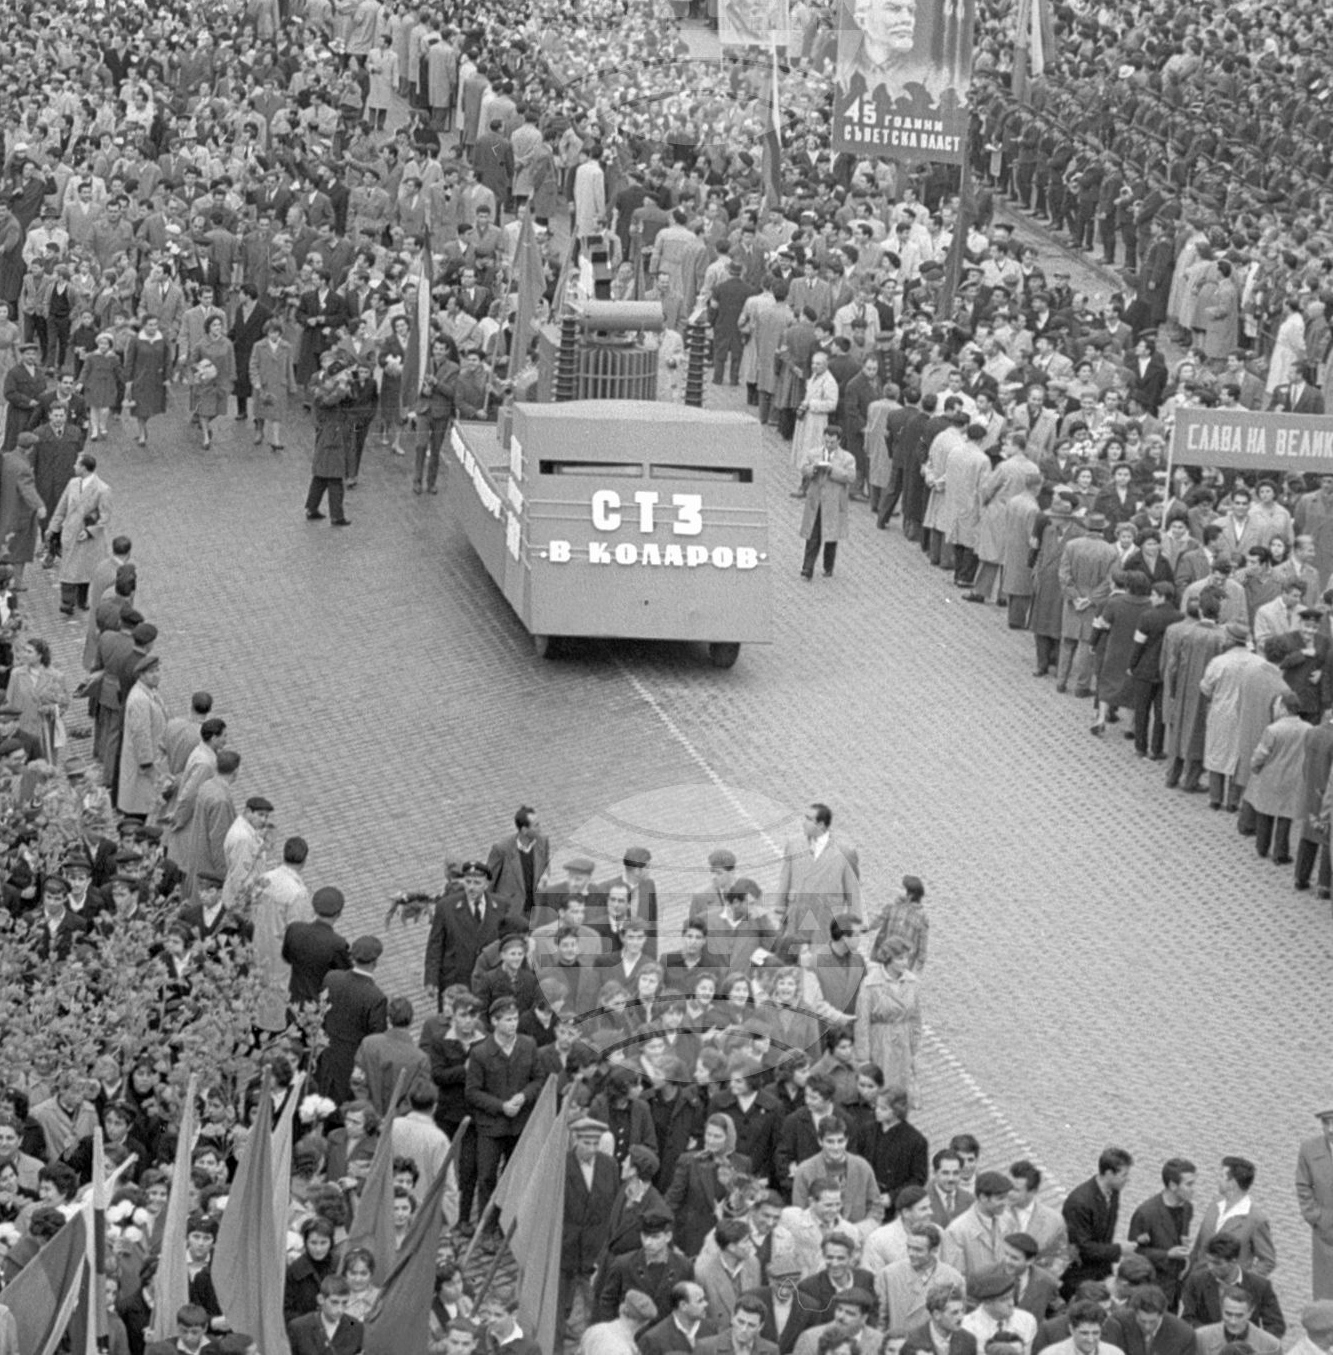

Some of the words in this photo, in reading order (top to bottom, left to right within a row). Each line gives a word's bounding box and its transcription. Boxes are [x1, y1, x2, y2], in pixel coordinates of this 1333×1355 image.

[843, 96, 878, 125] 45
[884, 114, 943, 132] ГОДИНИ
[844, 124, 918, 148] СЪВЕТСКА
[920, 132, 961, 152] ВЛАСТ
[1187, 424, 1242, 453] СЛАВА
[1247, 427, 1266, 455] НА
[591, 489, 703, 536] СТЗ
